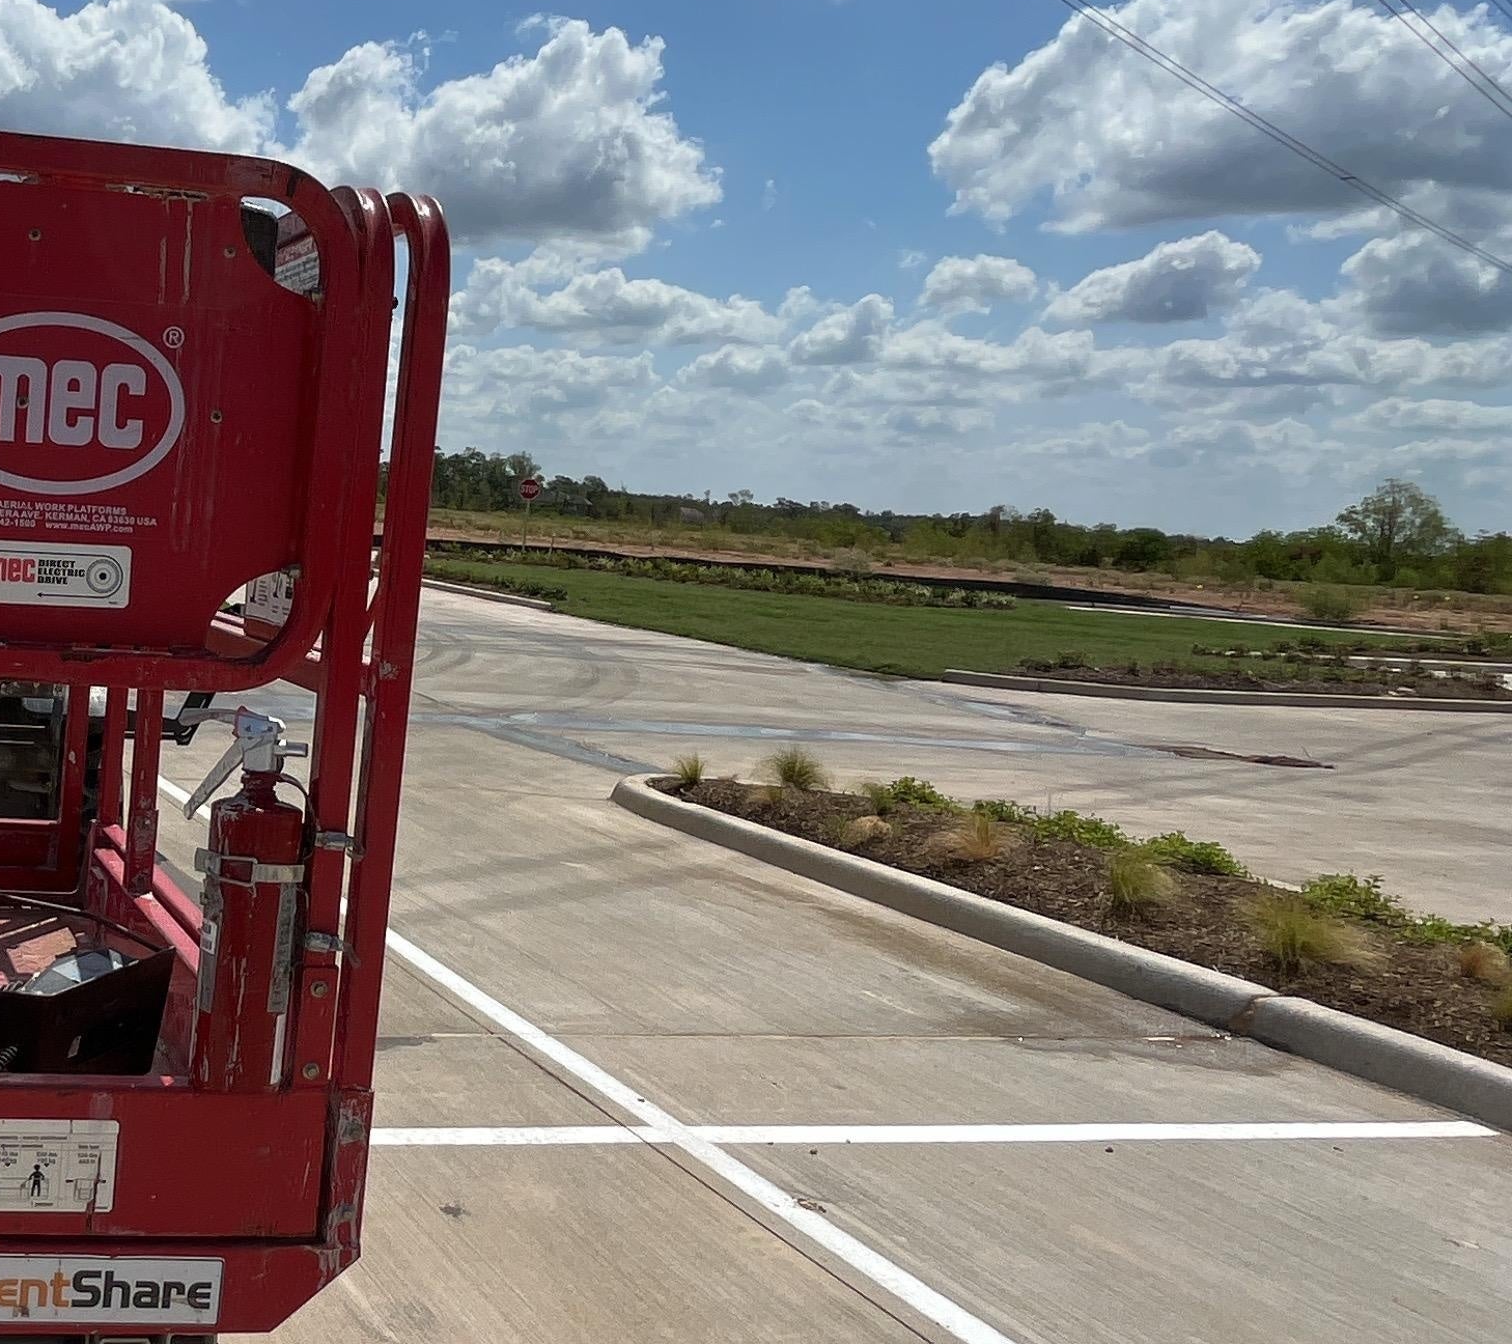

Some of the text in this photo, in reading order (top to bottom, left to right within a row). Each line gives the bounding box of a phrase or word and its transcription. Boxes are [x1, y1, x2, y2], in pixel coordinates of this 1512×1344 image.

[520, 485, 538, 494] STOP
[34, 502, 66, 512] WORK
[68, 504, 127, 516] PLATFORMS
[92, 514, 106, 523] CA
[136, 517, 158, 527] USA
[38, 559, 76, 569] DIRECT
[38, 568, 86, 578] ELECTRIC
[37, 576, 68, 585] DRIVE
